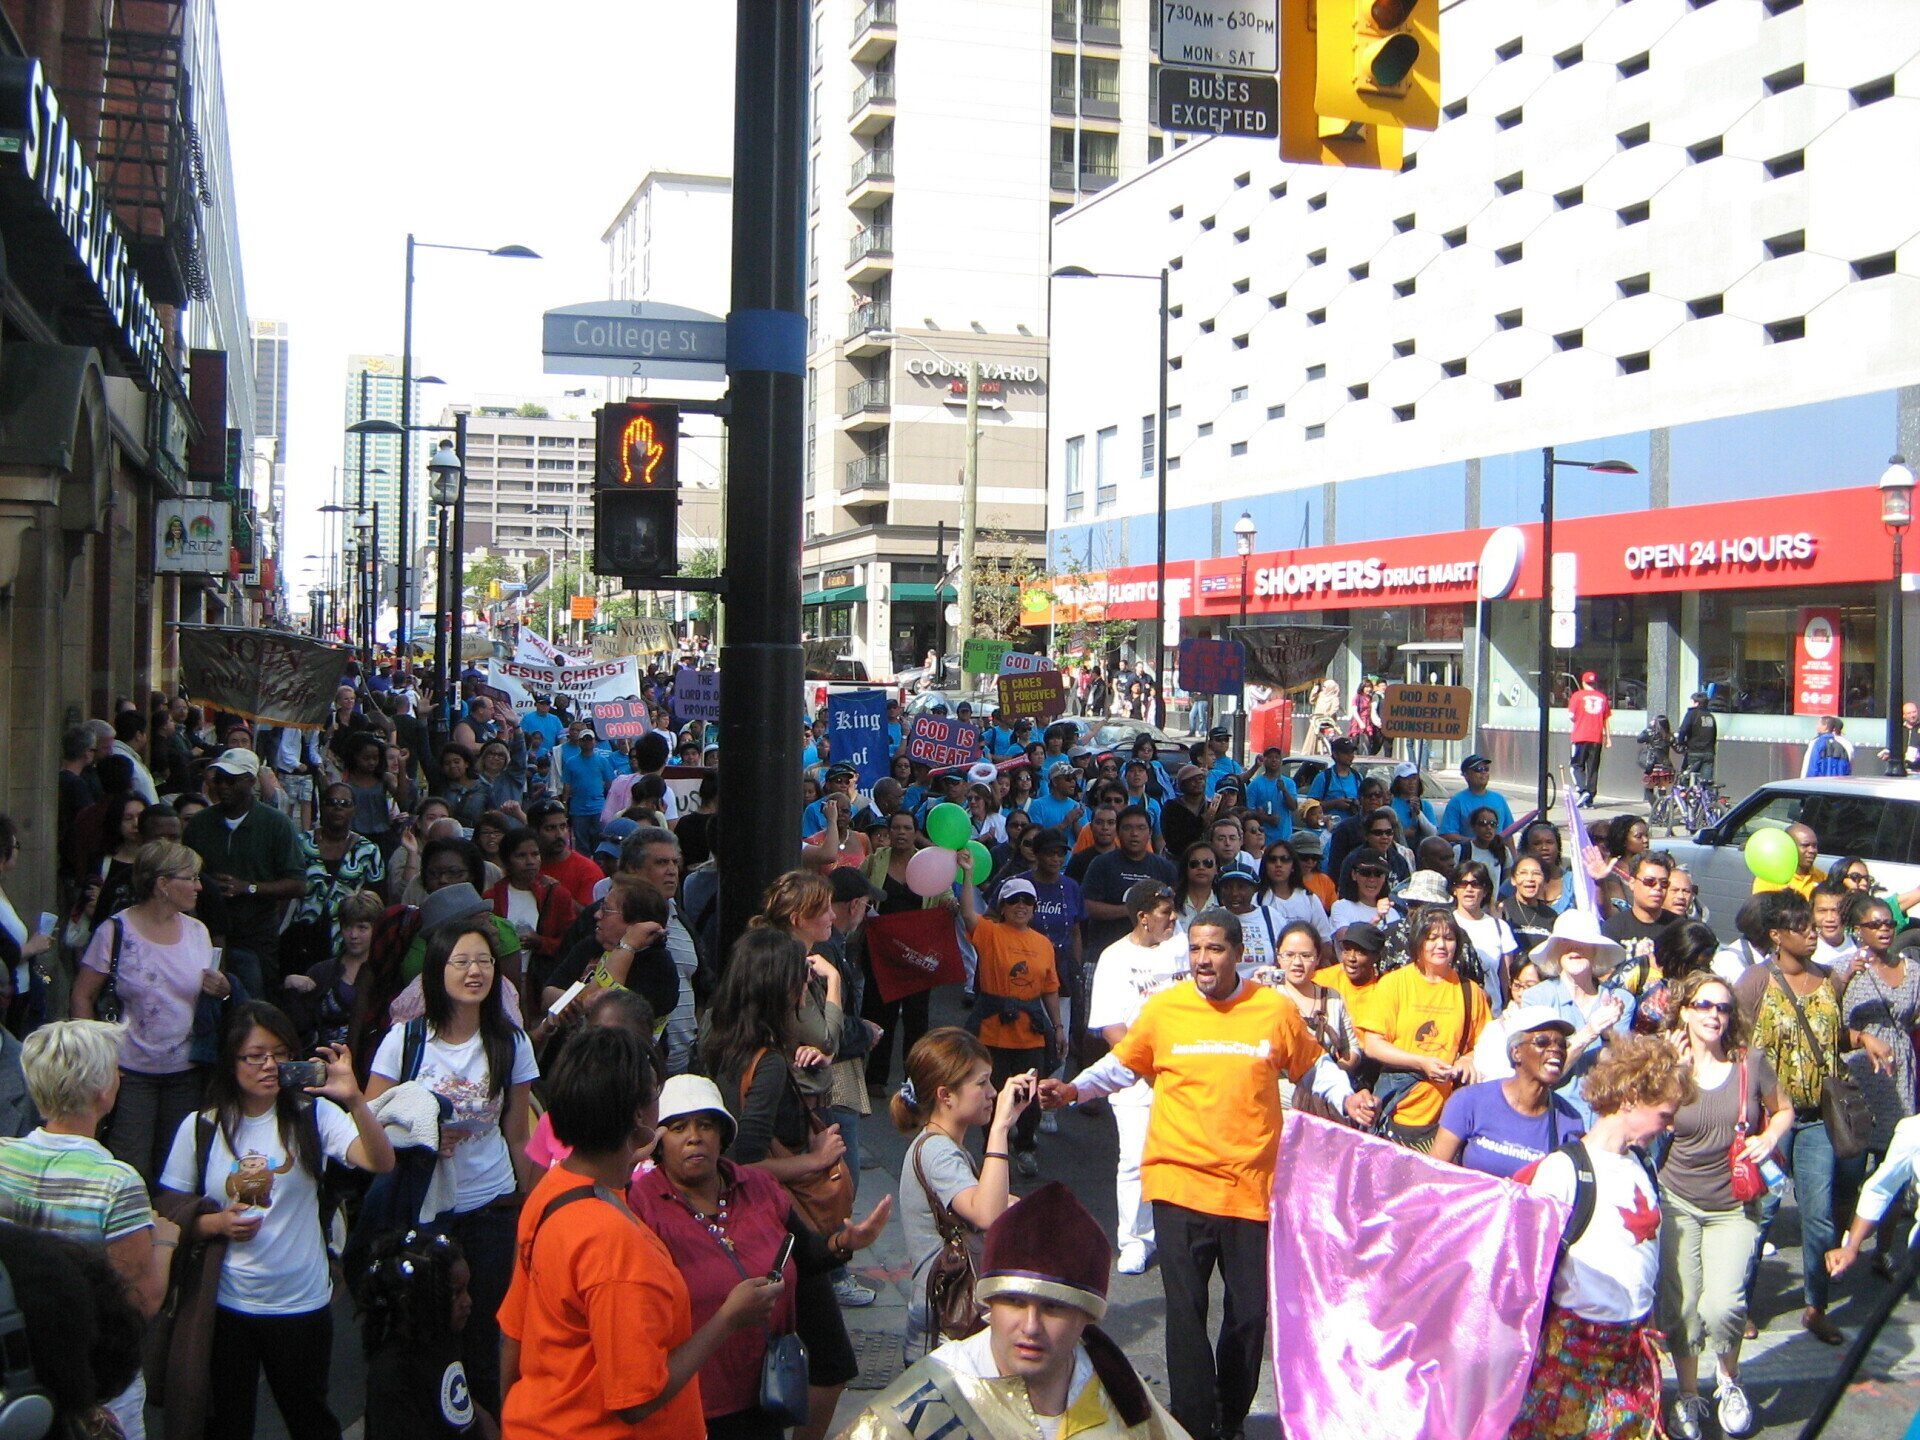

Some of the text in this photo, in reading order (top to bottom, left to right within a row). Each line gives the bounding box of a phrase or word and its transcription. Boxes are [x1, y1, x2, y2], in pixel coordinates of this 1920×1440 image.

[1183, 45, 1256, 66] MON SAT
[1188, 78, 1250, 103] BUSES
[1171, 104, 1267, 131] EXCEPTED
[24, 58, 128, 328] STARBUCKS
[574, 320, 698, 355] College St
[632, 362, 642, 375] 2
[905, 358, 1039, 382] COURYARD
[1624, 532, 1812, 571] OPEN 24 HOURS
[1254, 558, 1384, 596] SHOPPERS
[1383, 566, 1426, 587] DRUG
[1428, 561, 1479, 586] MART
[498, 661, 627, 683] JESUS CHRIST
[1006, 655, 1048, 672] GOD IS
[558, 681, 593, 692] Way!
[698, 675, 712, 685] THE
[1012, 677, 1042, 688] CARES
[680, 688, 700, 700] LORD
[703, 690, 712, 700] IS
[1013, 688, 1056, 701] FORGIVES
[1400, 690, 1422, 702] GOD
[1427, 692, 1439, 704] IS
[595, 702, 646, 719] GOD IS
[684, 705, 720, 716] PROVIDE
[1016, 702, 1043, 714] SAVES
[1390, 705, 1459, 720] WONDERFUL
[605, 721, 644, 737] GOOD
[835, 710, 881, 731] King
[1386, 720, 1461, 735] COUNSELLOR
[916, 718, 975, 747] GOD IS
[852, 747, 869, 766] of
[912, 739, 971, 765] GREAT
[902, 952, 936, 972] JESUS
